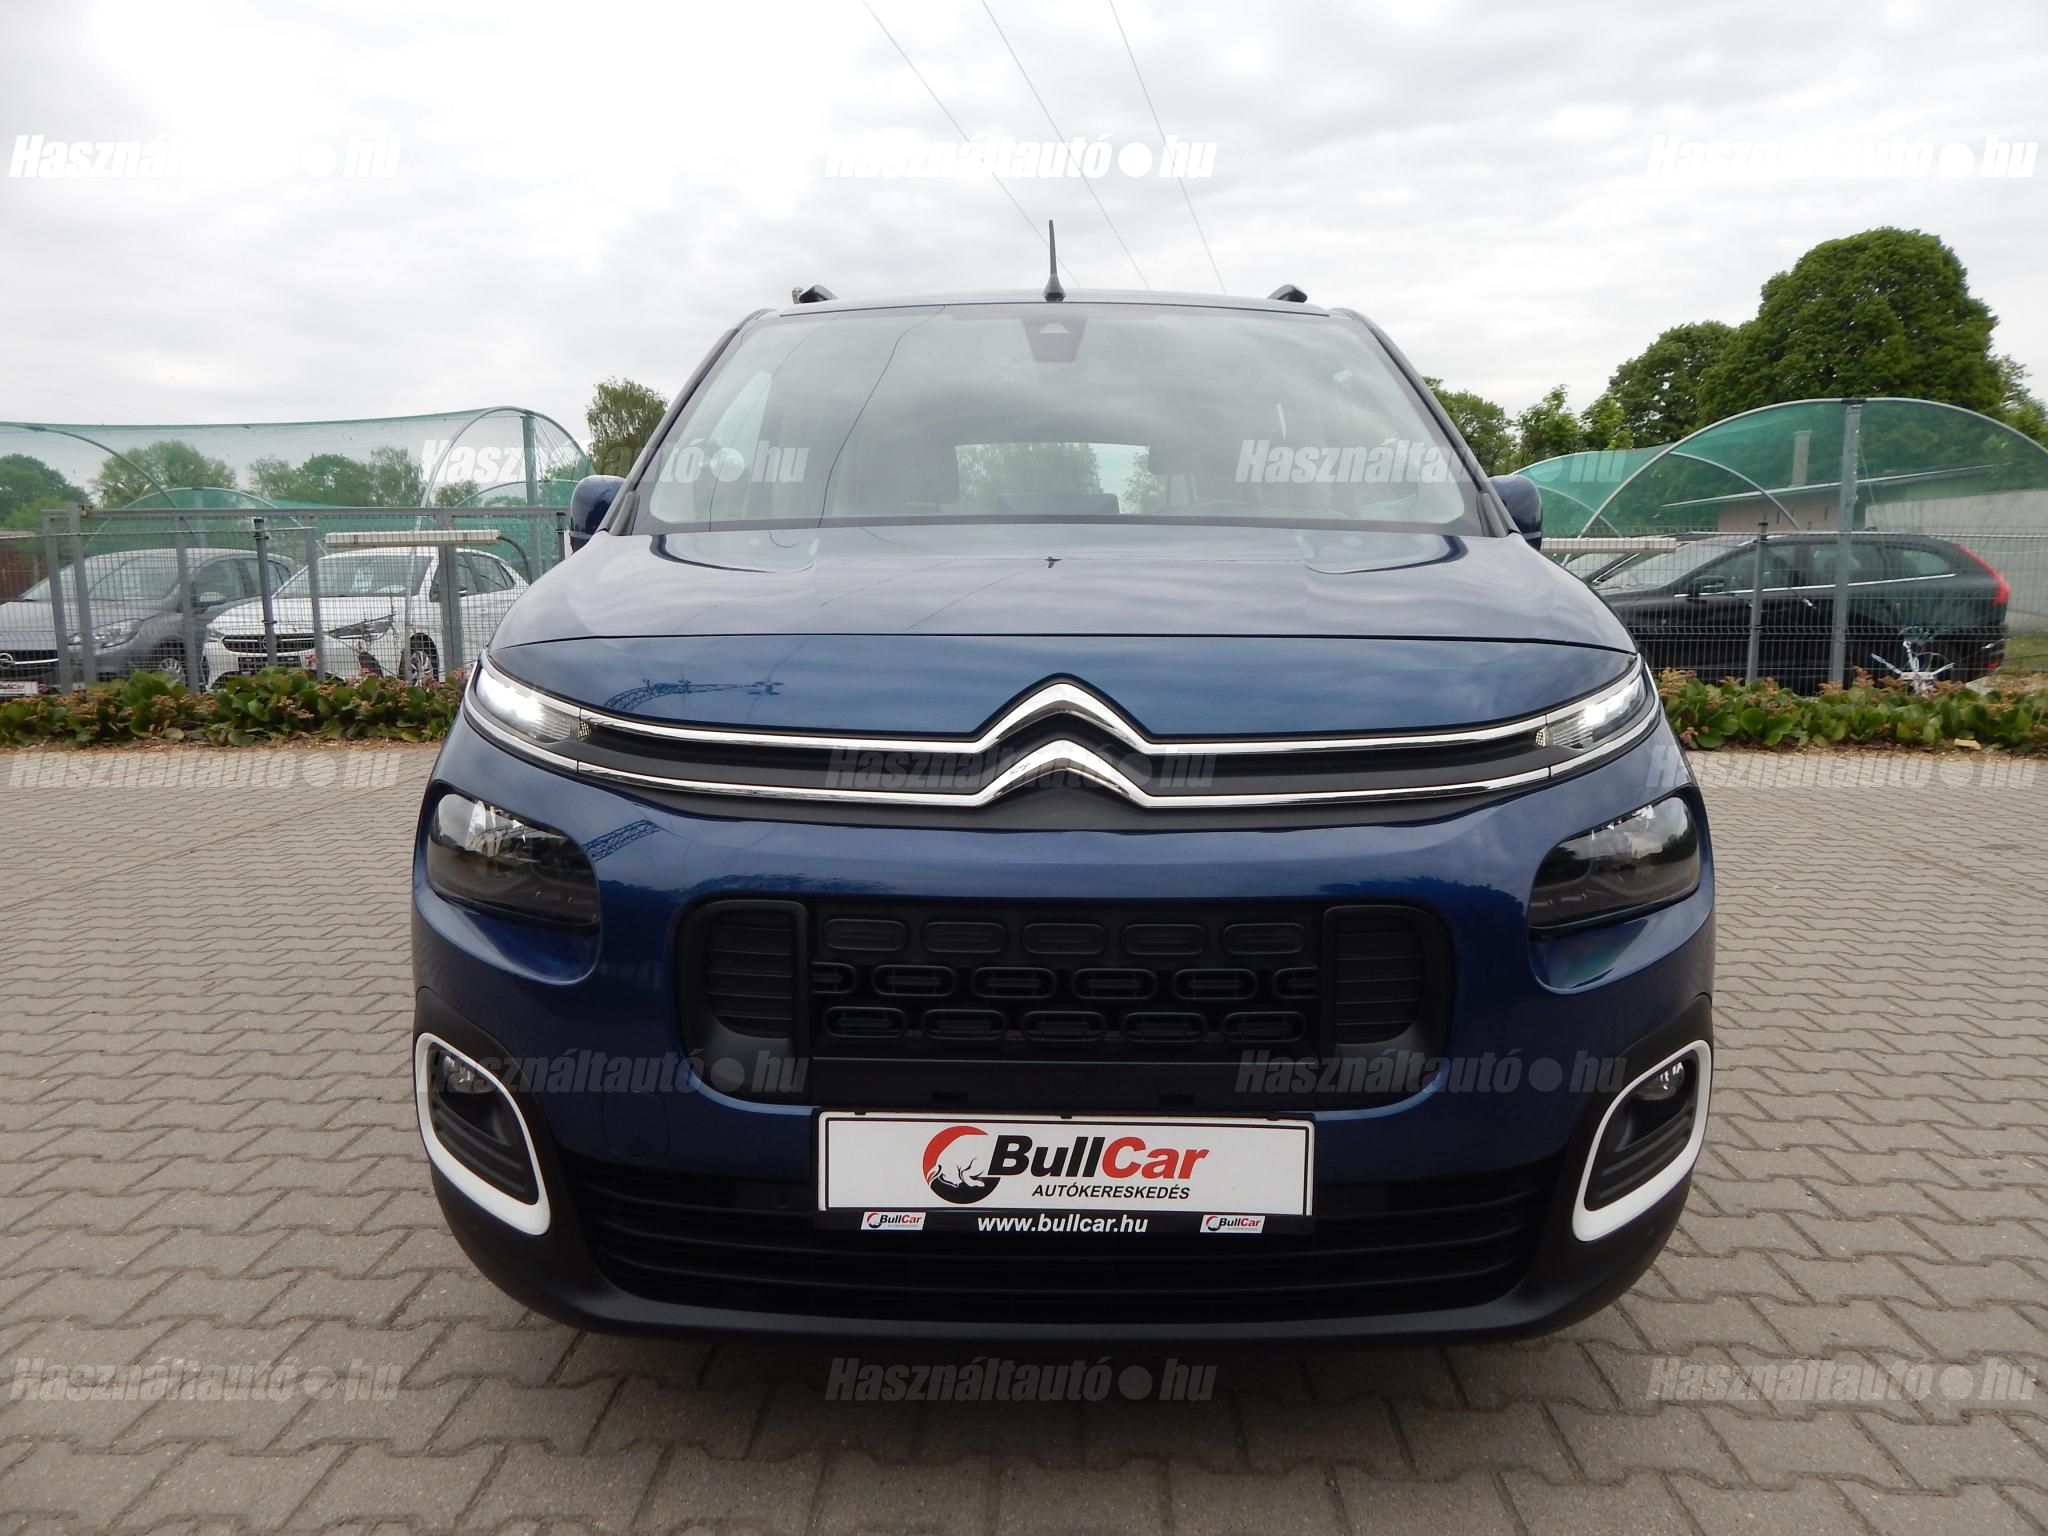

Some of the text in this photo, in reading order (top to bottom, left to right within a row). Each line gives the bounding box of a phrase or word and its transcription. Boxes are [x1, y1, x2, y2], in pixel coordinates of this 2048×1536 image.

[988, 1134, 1209, 1180] BullCar
[1031, 1181, 1191, 1200] AUTÓKERESKEDÉS
[880, 1214, 921, 1224] BullCar
[977, 1214, 1149, 1233] www.bullcar.hu
[1219, 1217, 1260, 1227] BullCar
